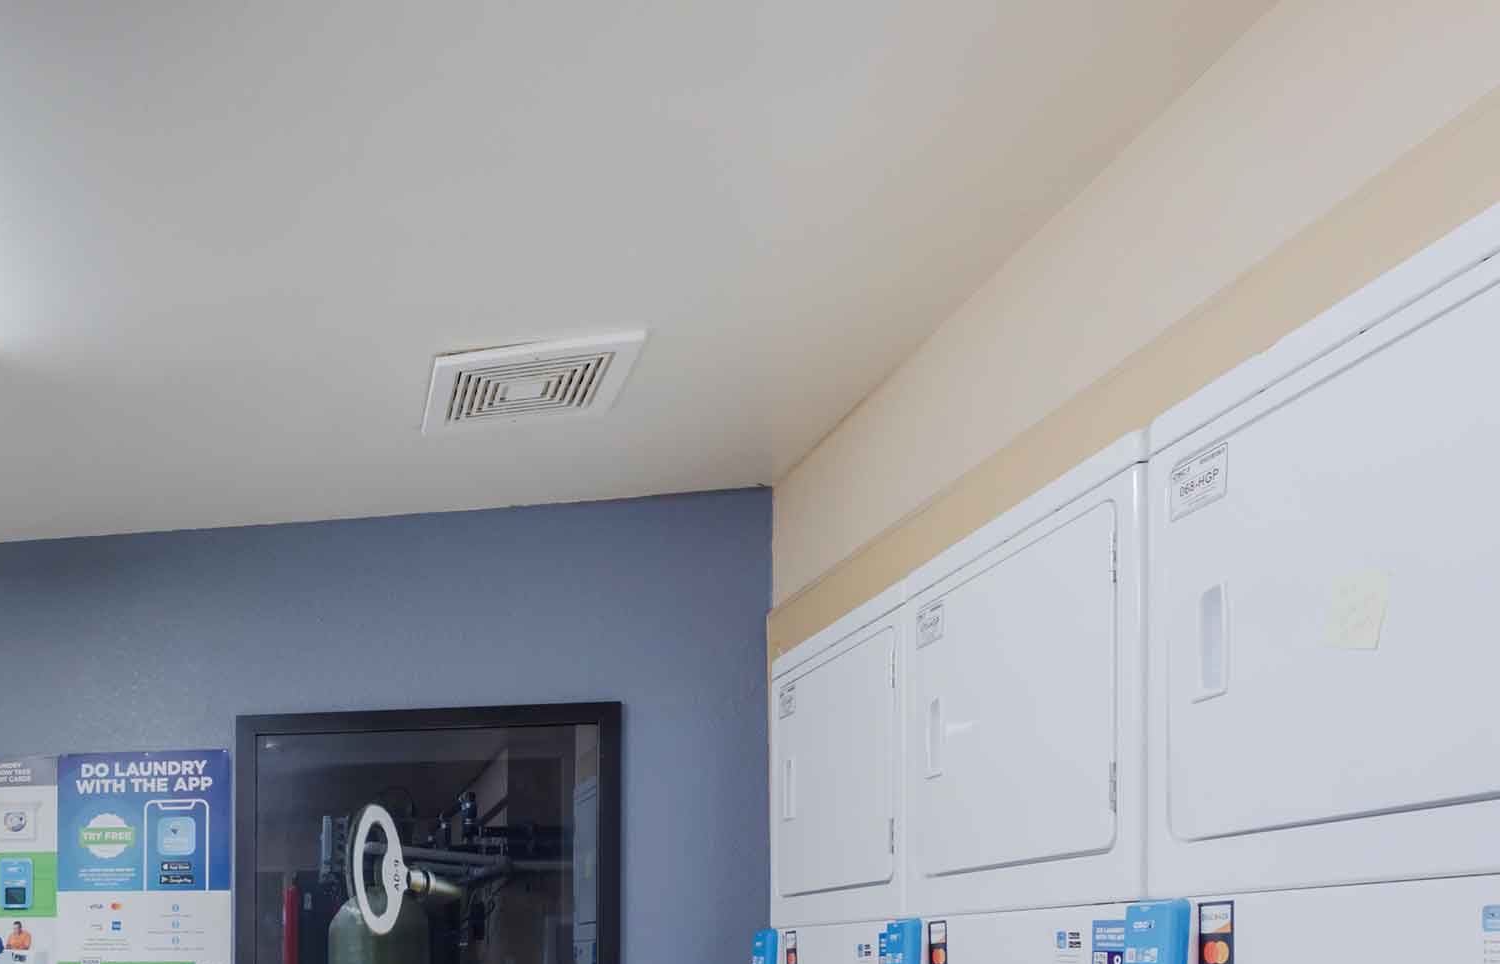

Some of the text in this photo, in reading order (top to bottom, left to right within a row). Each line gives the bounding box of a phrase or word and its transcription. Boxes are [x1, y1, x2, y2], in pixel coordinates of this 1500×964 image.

[81, 760, 207, 778] DO LAUNDRY
[75, 776, 213, 795] WITH THE APP
[83, 831, 133, 841] TRY FREE
